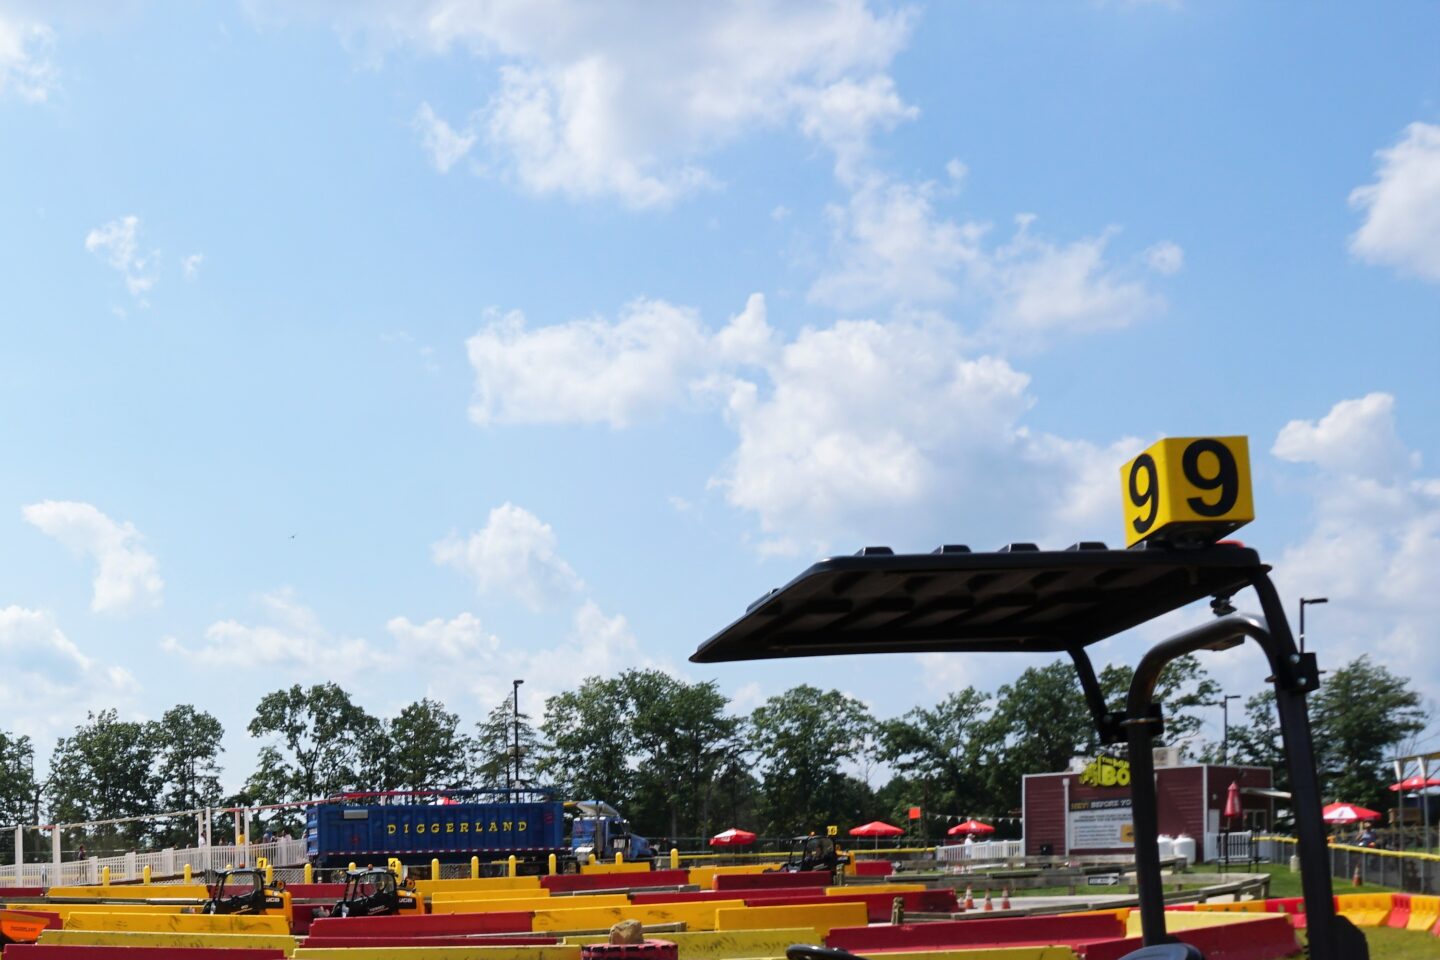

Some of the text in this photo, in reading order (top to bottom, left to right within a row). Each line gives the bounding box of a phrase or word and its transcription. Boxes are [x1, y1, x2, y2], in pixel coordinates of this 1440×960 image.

[1182, 438, 1239, 517] 9
[1128, 453, 1159, 534] 9
[1102, 764, 1131, 787] BO
[1120, 799, 1132, 807] YO
[387, 820, 528, 835] DIGGERLAND
